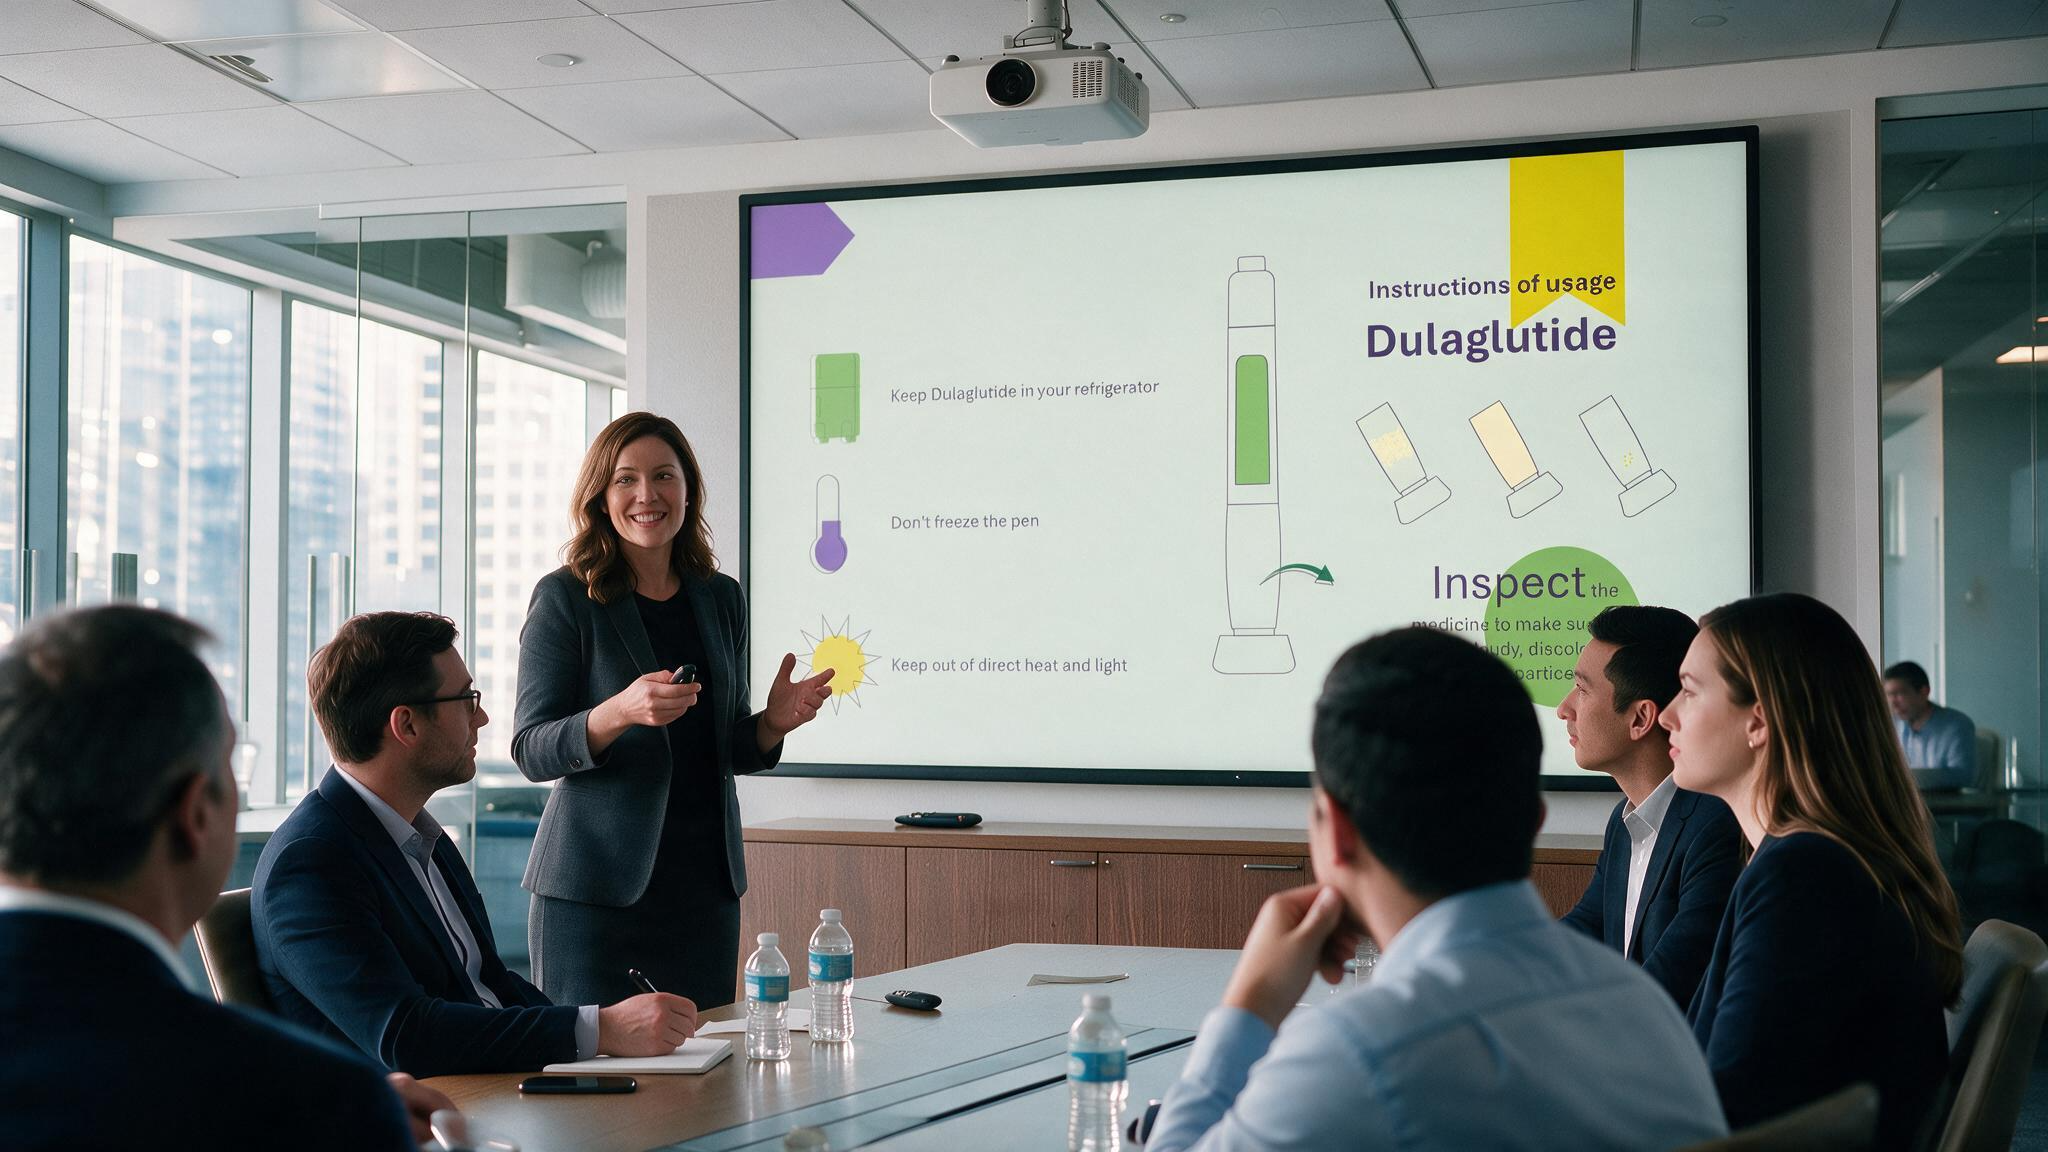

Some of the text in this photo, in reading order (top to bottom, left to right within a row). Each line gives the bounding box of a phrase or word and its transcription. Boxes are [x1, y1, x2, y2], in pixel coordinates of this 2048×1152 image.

[1369, 274, 1617, 299] Instructions of usage
[1367, 317, 1617, 363] Dulaglutide
[891, 380, 1160, 405] Keep Dulaglutide in your refrigerator
[891, 514, 1039, 532] Don't freeze the pen
[1434, 565, 1619, 607] Inspect the
[1411, 616, 1489, 631] medicine
[1495, 617, 1510, 631] to
[1516, 616, 1562, 631] make
[892, 657, 1128, 676] Keep out of direct heat and light
